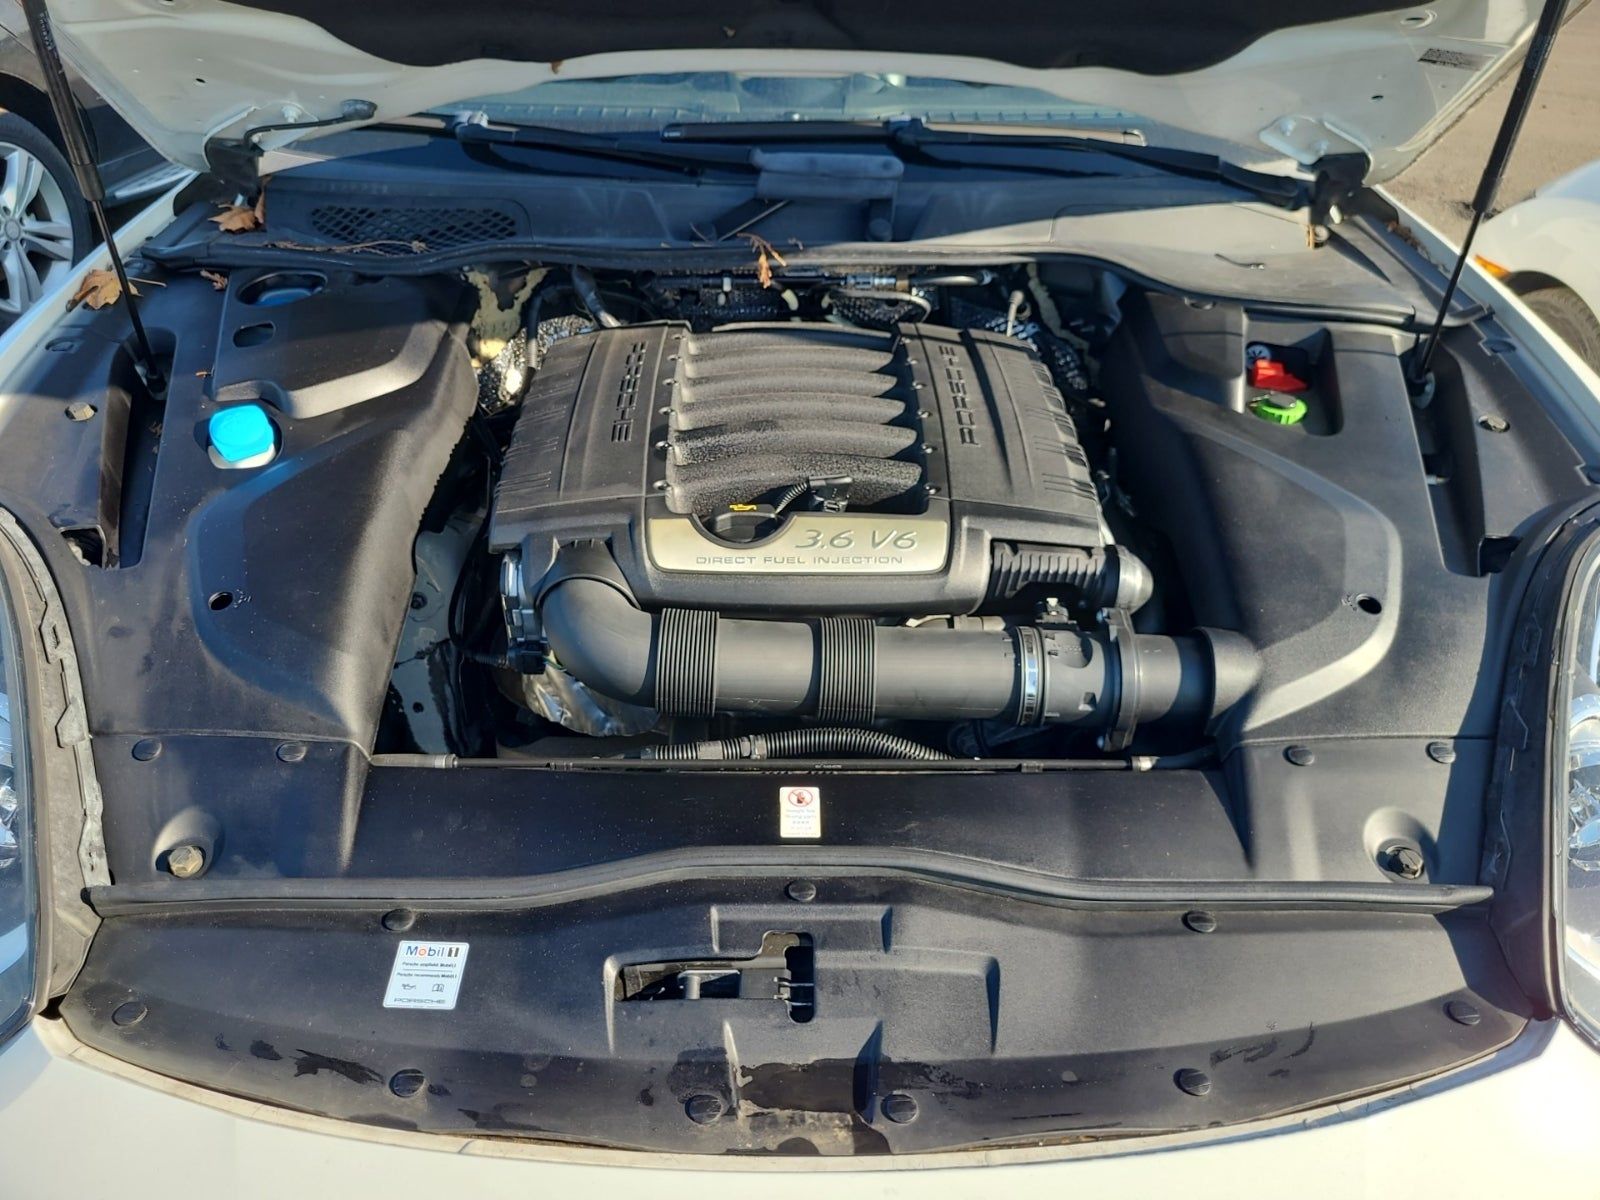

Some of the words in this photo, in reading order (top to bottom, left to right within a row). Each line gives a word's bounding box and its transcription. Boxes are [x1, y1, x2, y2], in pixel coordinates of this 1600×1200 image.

[611, 341, 648, 443] PORSCHE
[938, 344, 981, 446] PORSCHE
[794, 528, 856, 550] 3.6
[869, 528, 918, 551] V6
[695, 556, 757, 565] DIRECT
[763, 556, 806, 565] FUEL
[813, 556, 904, 565] INJECTION
[405, 946, 444, 957] Mobil
[394, 997, 446, 1005] PORSCHE
